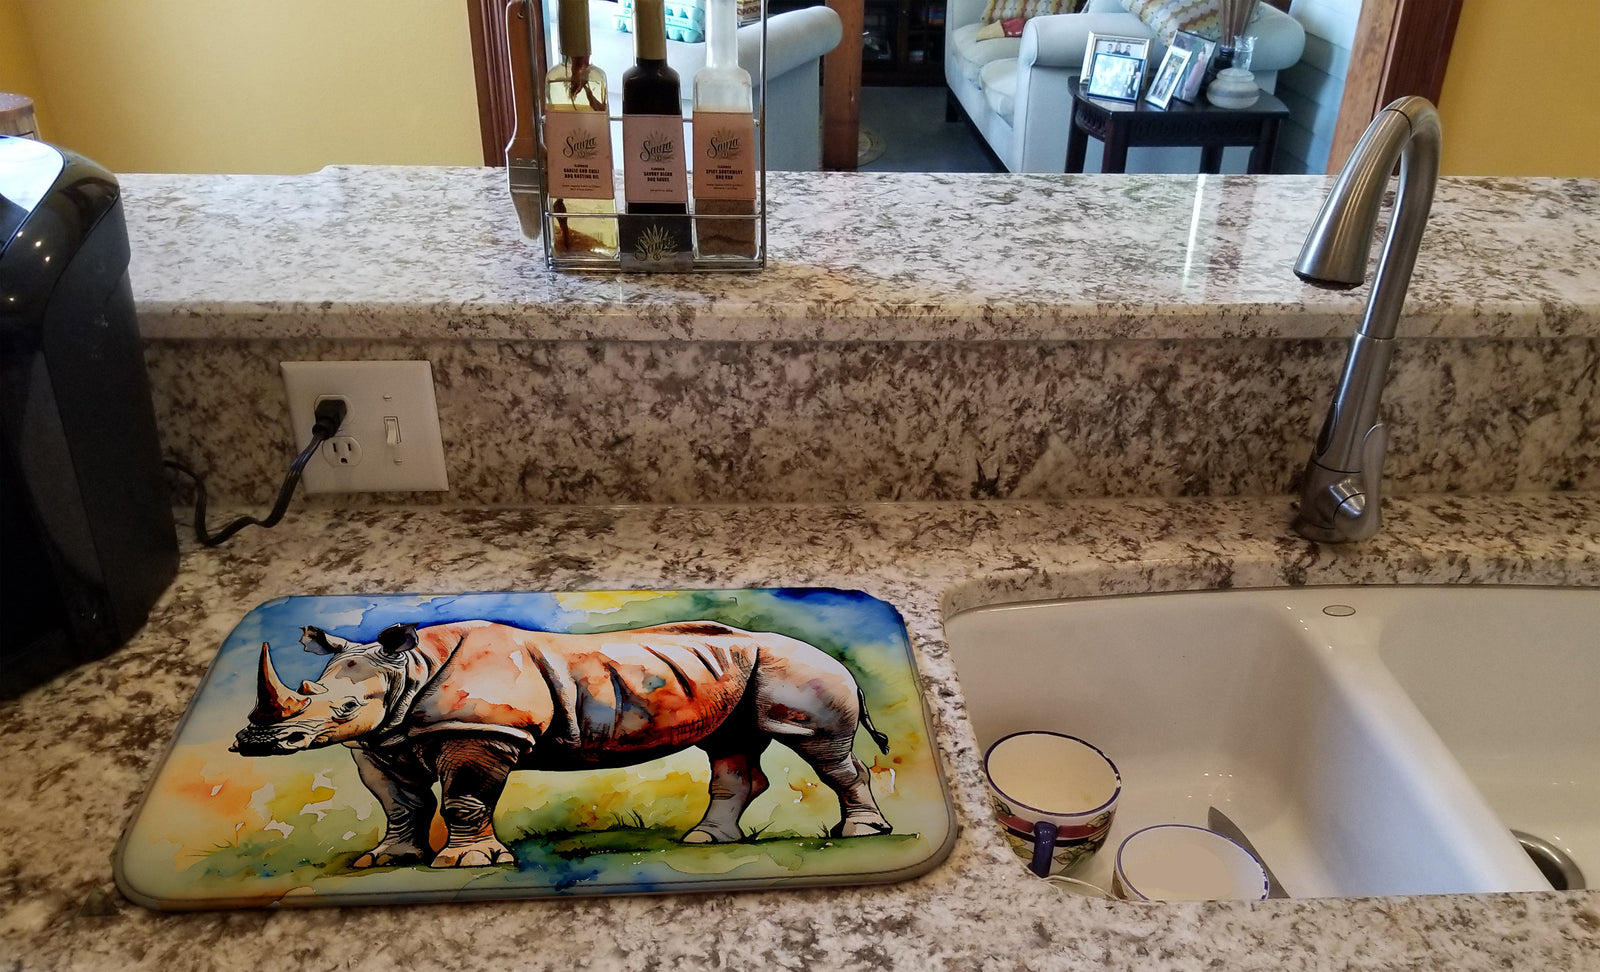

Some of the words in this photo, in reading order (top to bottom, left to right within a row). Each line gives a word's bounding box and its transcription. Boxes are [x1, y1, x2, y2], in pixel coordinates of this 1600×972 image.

[563, 136, 598, 158] Sauza
[640, 141, 674, 161] Sauza
[707, 137, 740, 158] Sauza
